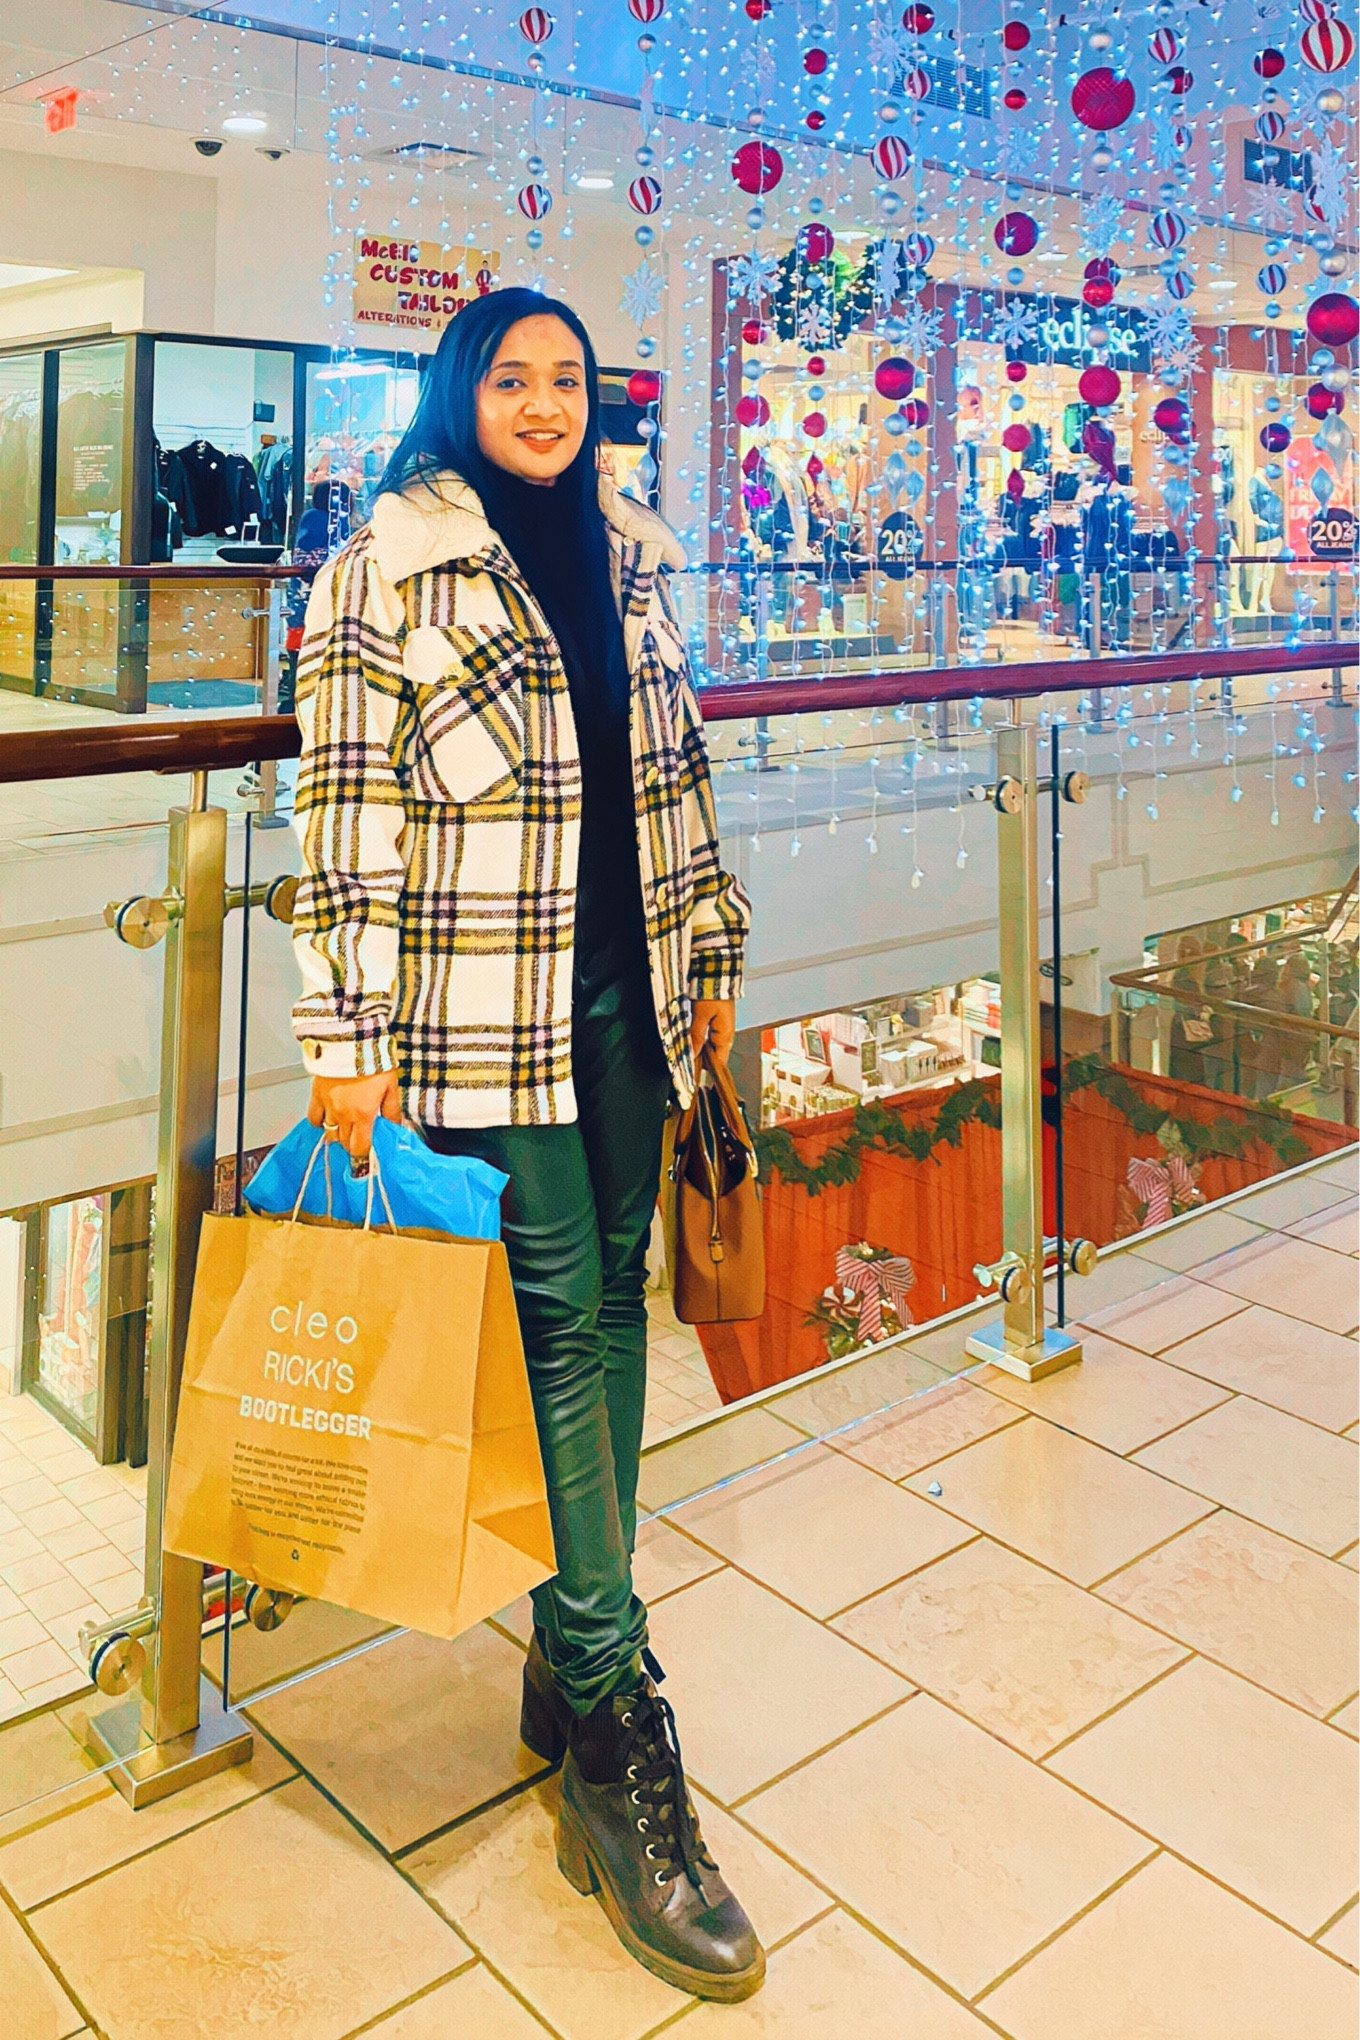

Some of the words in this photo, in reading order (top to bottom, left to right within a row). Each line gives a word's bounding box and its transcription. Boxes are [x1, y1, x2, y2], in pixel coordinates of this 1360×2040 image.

[369, 263, 459, 290] CUSTOM
[1042, 307, 1139, 365] eclise
[270, 1300, 358, 1344] cleo
[263, 1350, 355, 1394] RICKI'S
[239, 1394, 371, 1441] BOOTLEGGER
